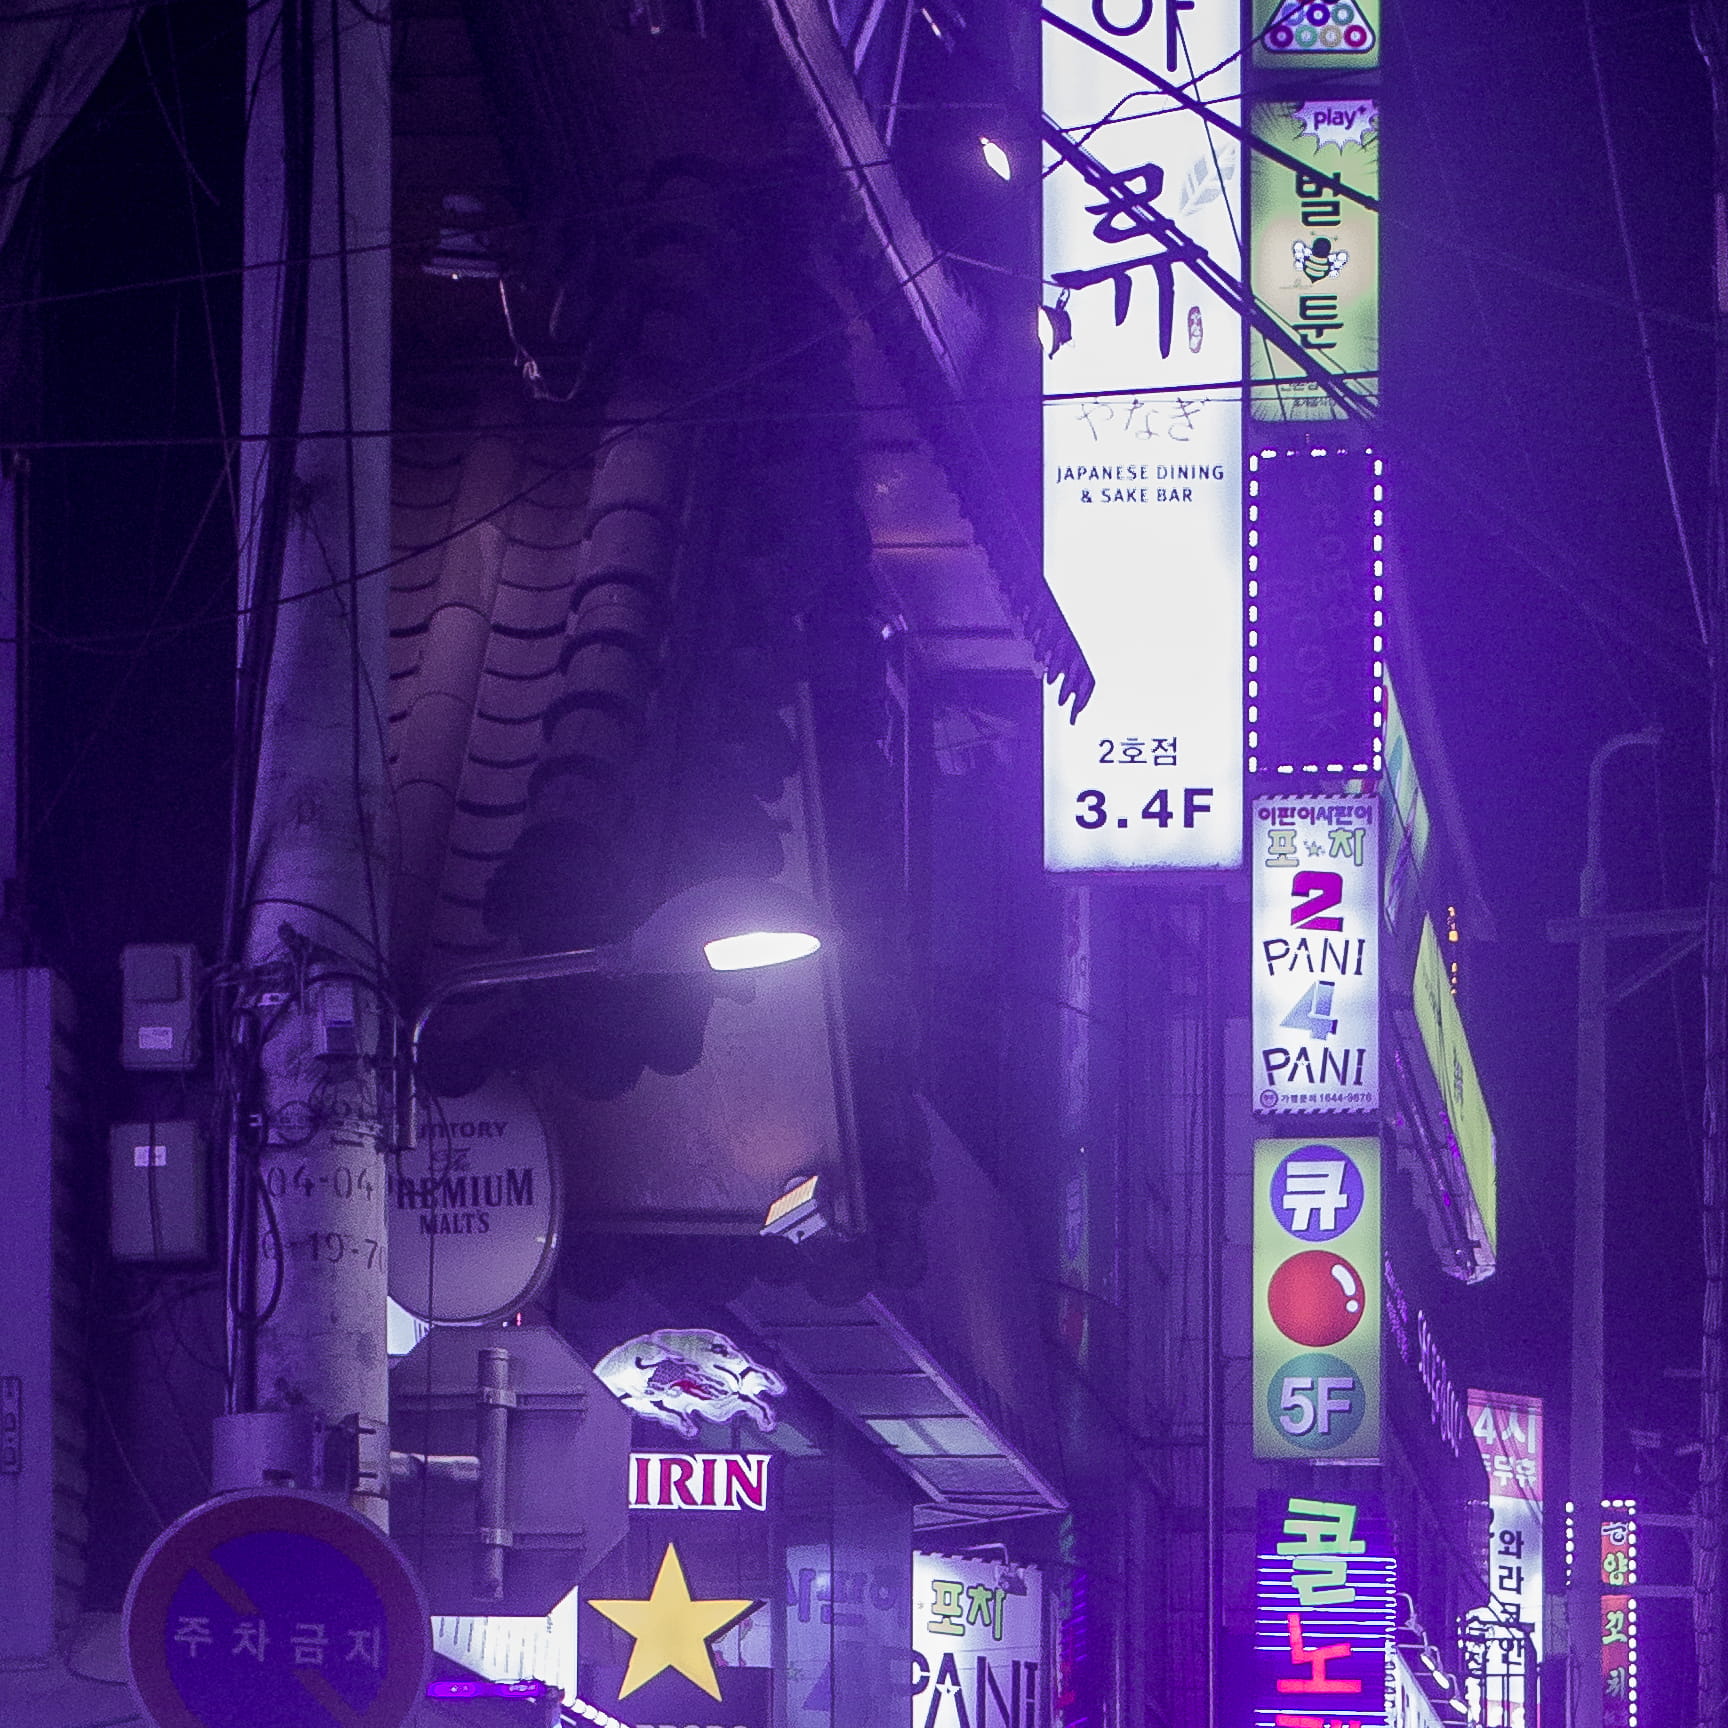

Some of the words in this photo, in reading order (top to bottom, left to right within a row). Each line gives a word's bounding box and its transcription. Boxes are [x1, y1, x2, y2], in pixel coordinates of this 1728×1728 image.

[1076, 397, 1211, 441] やなぎ
[1057, 464, 1149, 483] JAPANESE
[1156, 463, 1224, 482] DINING
[1081, 488, 1094, 504] &
[1100, 487, 1151, 504] SAKE
[1157, 487, 1194, 504] BAR
[1099, 736, 1179, 767] 2호점
[1074, 786, 1214, 830] 3.4F
[1290, 870, 1343, 932] 2
[1263, 936, 1366, 977] PANI
[1279, 980, 1339, 1041] 4
[1262, 1046, 1366, 1087] PANI
[387, 1167, 534, 1210] REMIUM
[1283, 1160, 1348, 1231] 큐
[1278, 1376, 1356, 1437] 5F
[1473, 1402, 1537, 1454] 4시
[630, 1453, 771, 1511] IRIN
[1276, 1497, 1367, 1606] 콜
[174, 1615, 382, 1671] 주차금지
